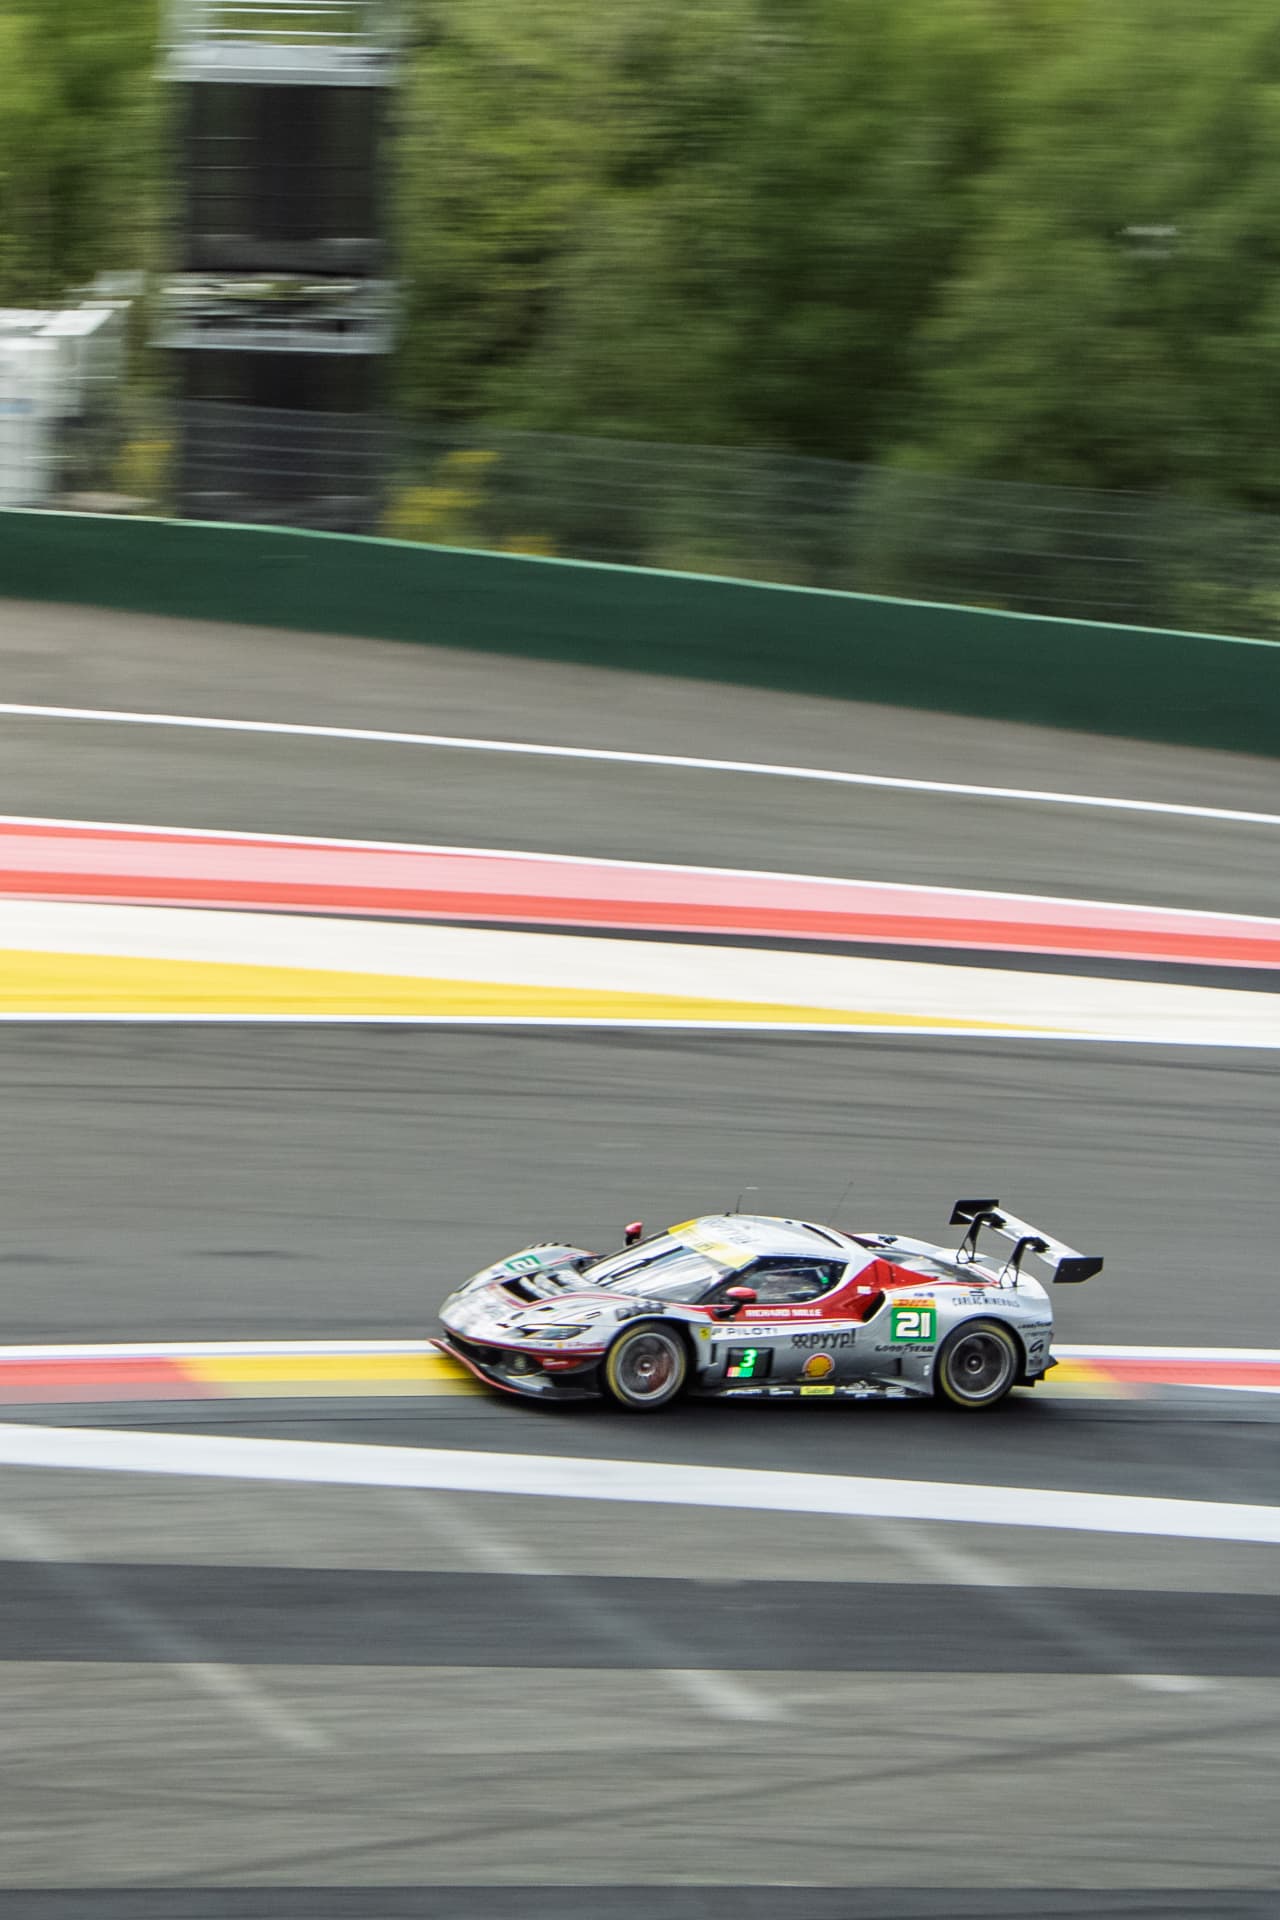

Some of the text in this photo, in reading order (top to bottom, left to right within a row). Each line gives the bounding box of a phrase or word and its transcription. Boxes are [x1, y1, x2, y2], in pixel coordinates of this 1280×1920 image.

[727, 1327, 778, 1336] PILOTI
[895, 1311, 931, 1338] 21
[740, 1348, 758, 1368] 3
